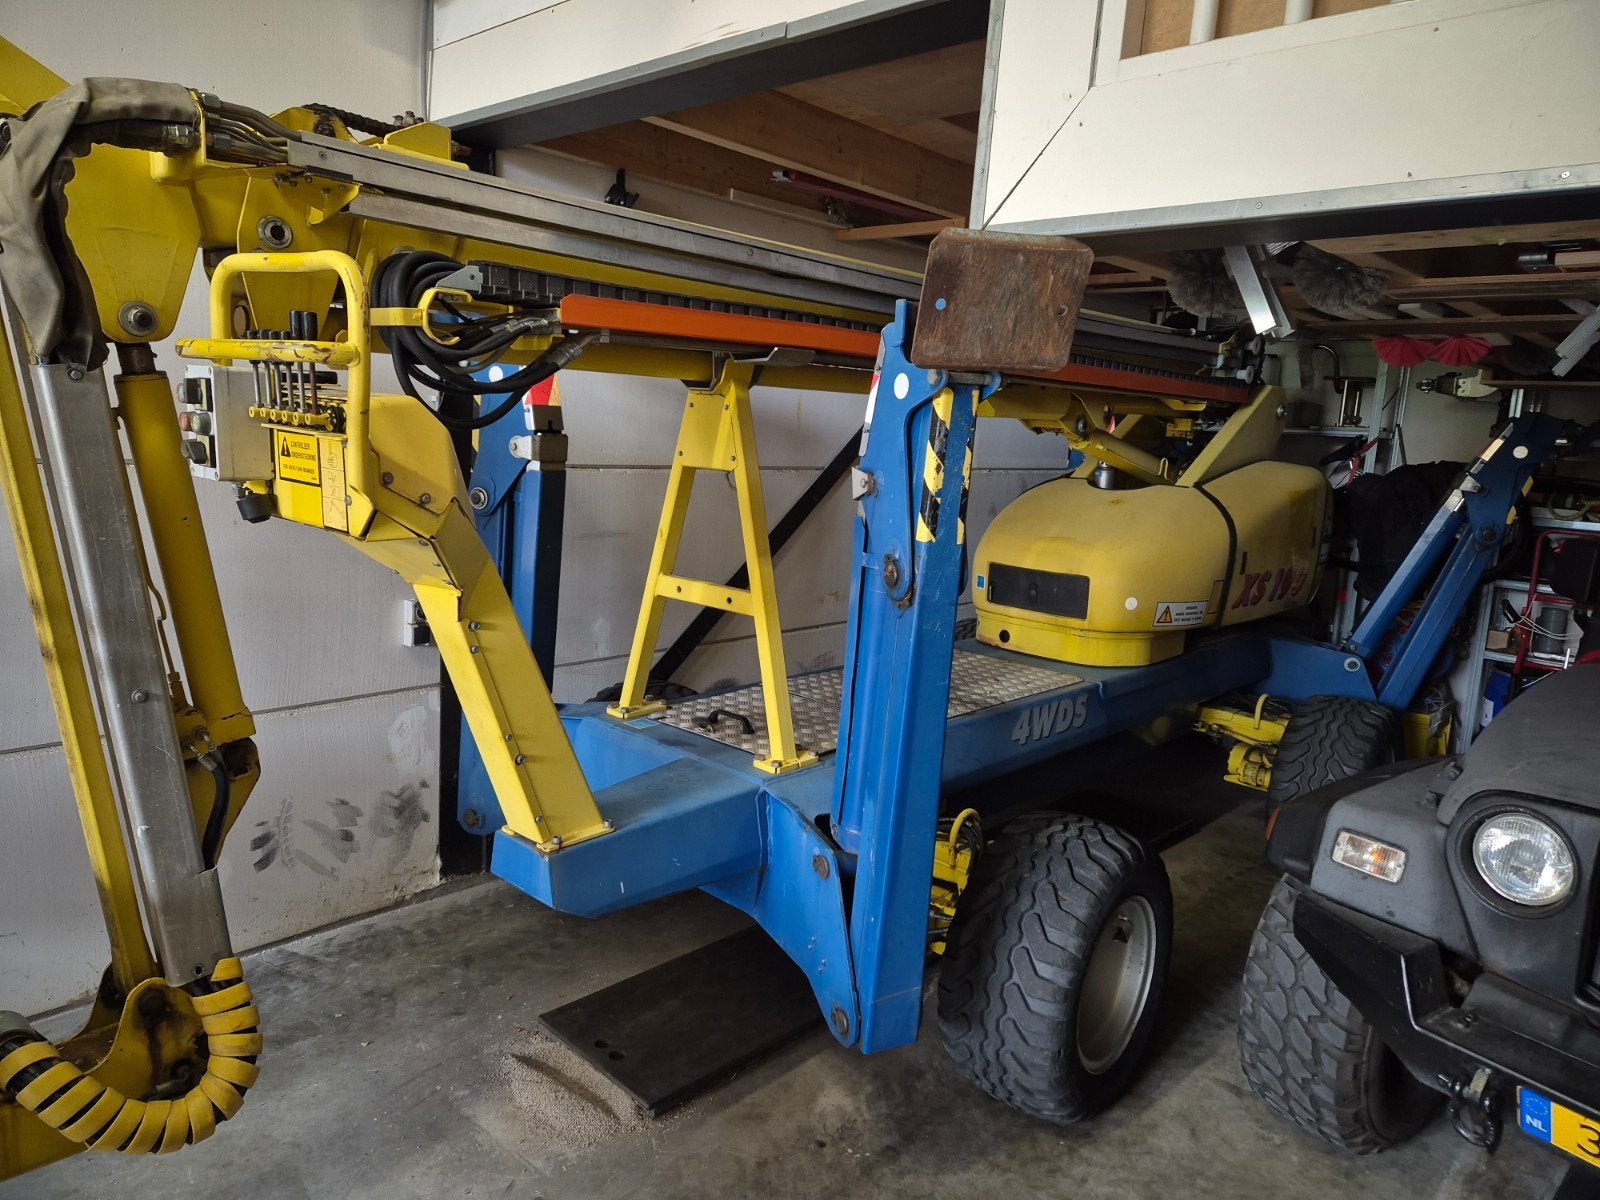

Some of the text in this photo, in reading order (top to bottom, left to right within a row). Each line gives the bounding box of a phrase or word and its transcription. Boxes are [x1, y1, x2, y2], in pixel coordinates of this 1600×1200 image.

[1231, 571, 1273, 609] XS
[1011, 694, 1088, 746] 4WDS
[1525, 1114, 1547, 1132] NL
